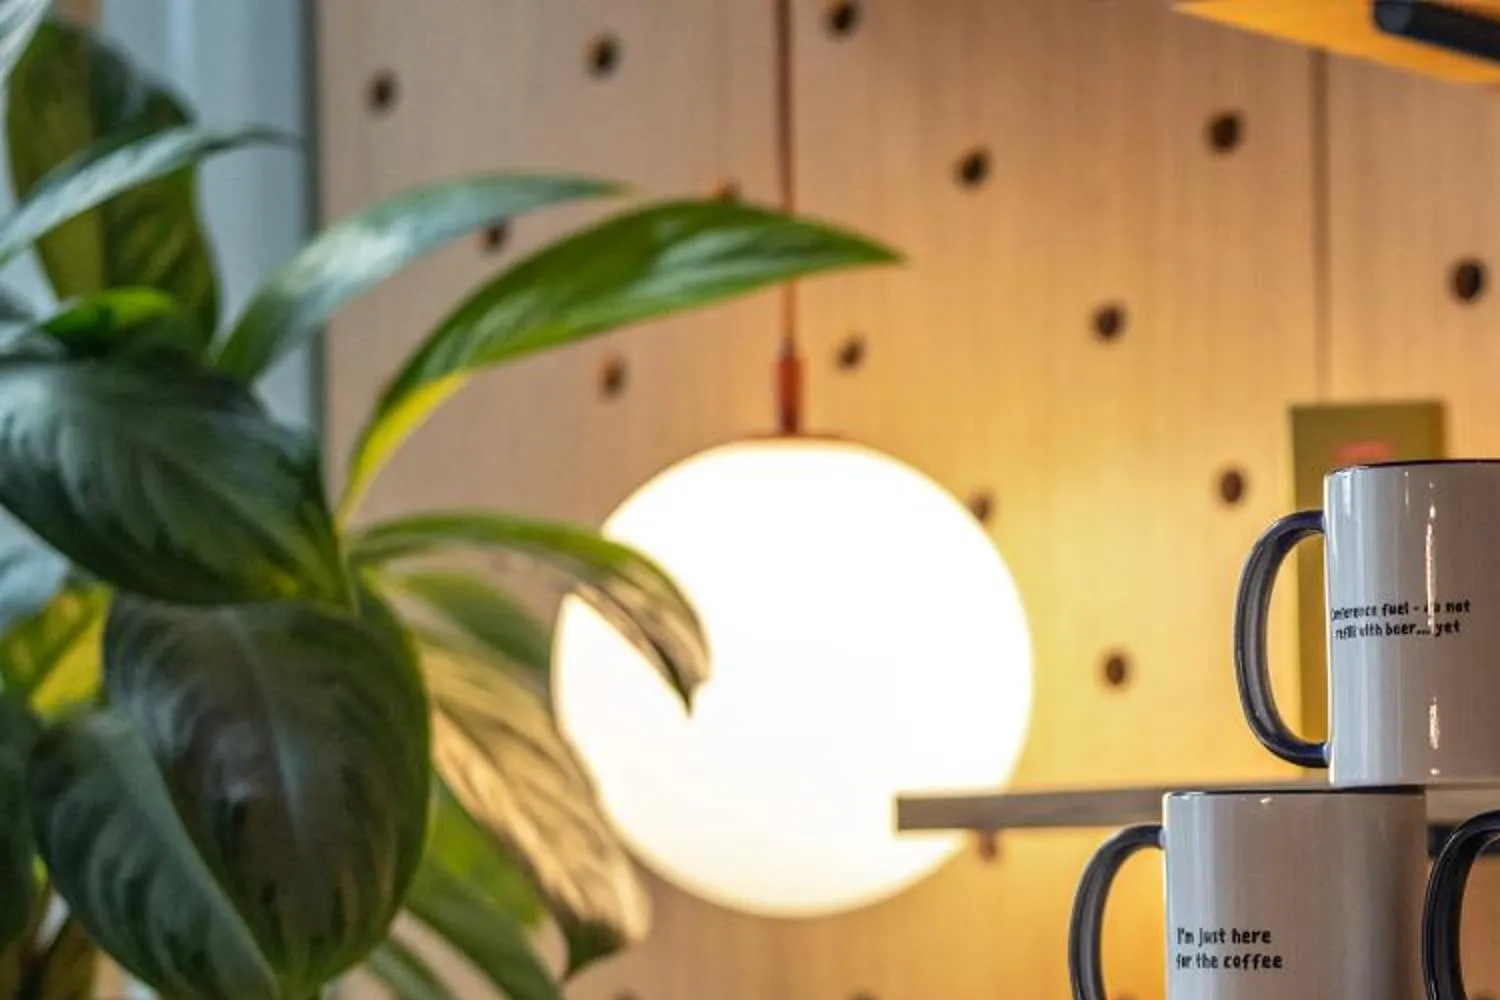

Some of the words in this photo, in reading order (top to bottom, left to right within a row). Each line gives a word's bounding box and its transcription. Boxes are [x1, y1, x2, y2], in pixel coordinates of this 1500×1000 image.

[1381, 601, 1409, 617] fuel
[1445, 599, 1470, 613] not
[1434, 620, 1460, 637] yet
[1177, 928, 1194, 944] I'm
[1198, 928, 1226, 947] just
[1232, 928, 1271, 944] here
[1176, 953, 1192, 969] for
[1196, 953, 1219, 969] the
[1223, 953, 1283, 970] coffee
